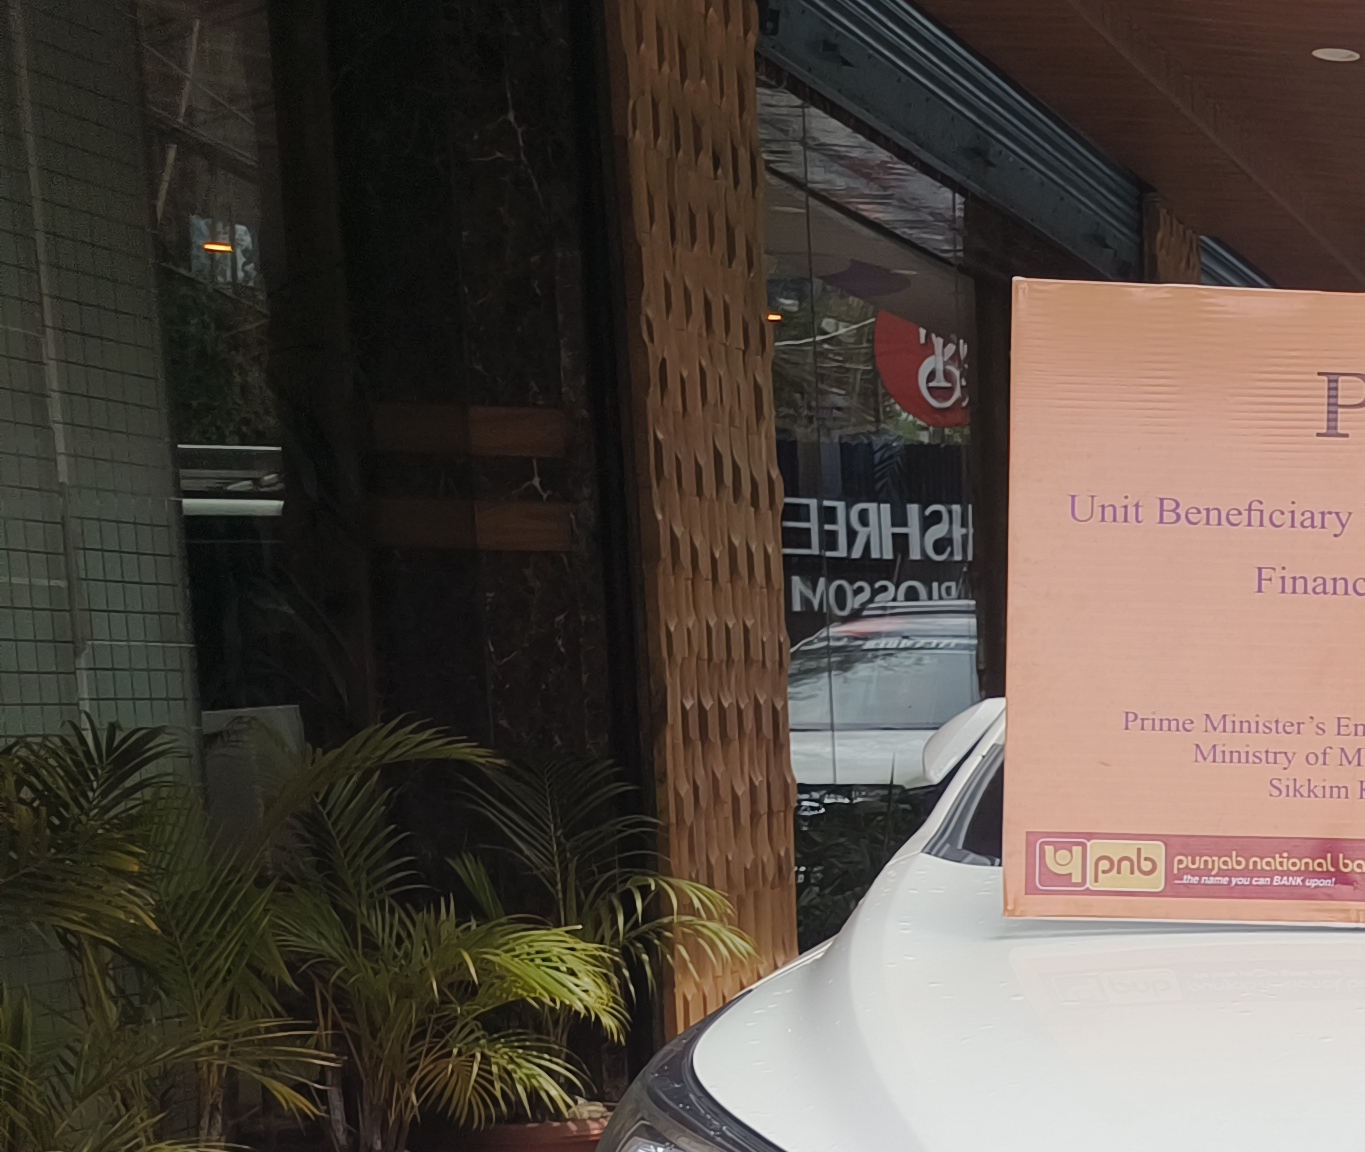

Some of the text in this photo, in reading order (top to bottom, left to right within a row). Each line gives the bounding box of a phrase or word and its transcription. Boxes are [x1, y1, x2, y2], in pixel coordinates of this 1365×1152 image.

[1068, 494, 1144, 524] Unit
[1157, 497, 1353, 539] Beneficiary
[1122, 710, 1195, 733] Prime
[1192, 743, 1298, 771] Ministry
[1305, 746, 1335, 768] of
[1268, 777, 1350, 800] Sikkim
[1093, 847, 1158, 884] pnb
[1173, 851, 1247, 874] punjab
[1248, 853, 1335, 873] national
[1201, 874, 1230, 886] name
[1231, 876, 1251, 889] you
[1252, 876, 1272, 887] can
[1273, 875, 1304, 887] BANK
[1305, 877, 1336, 889] upon!
